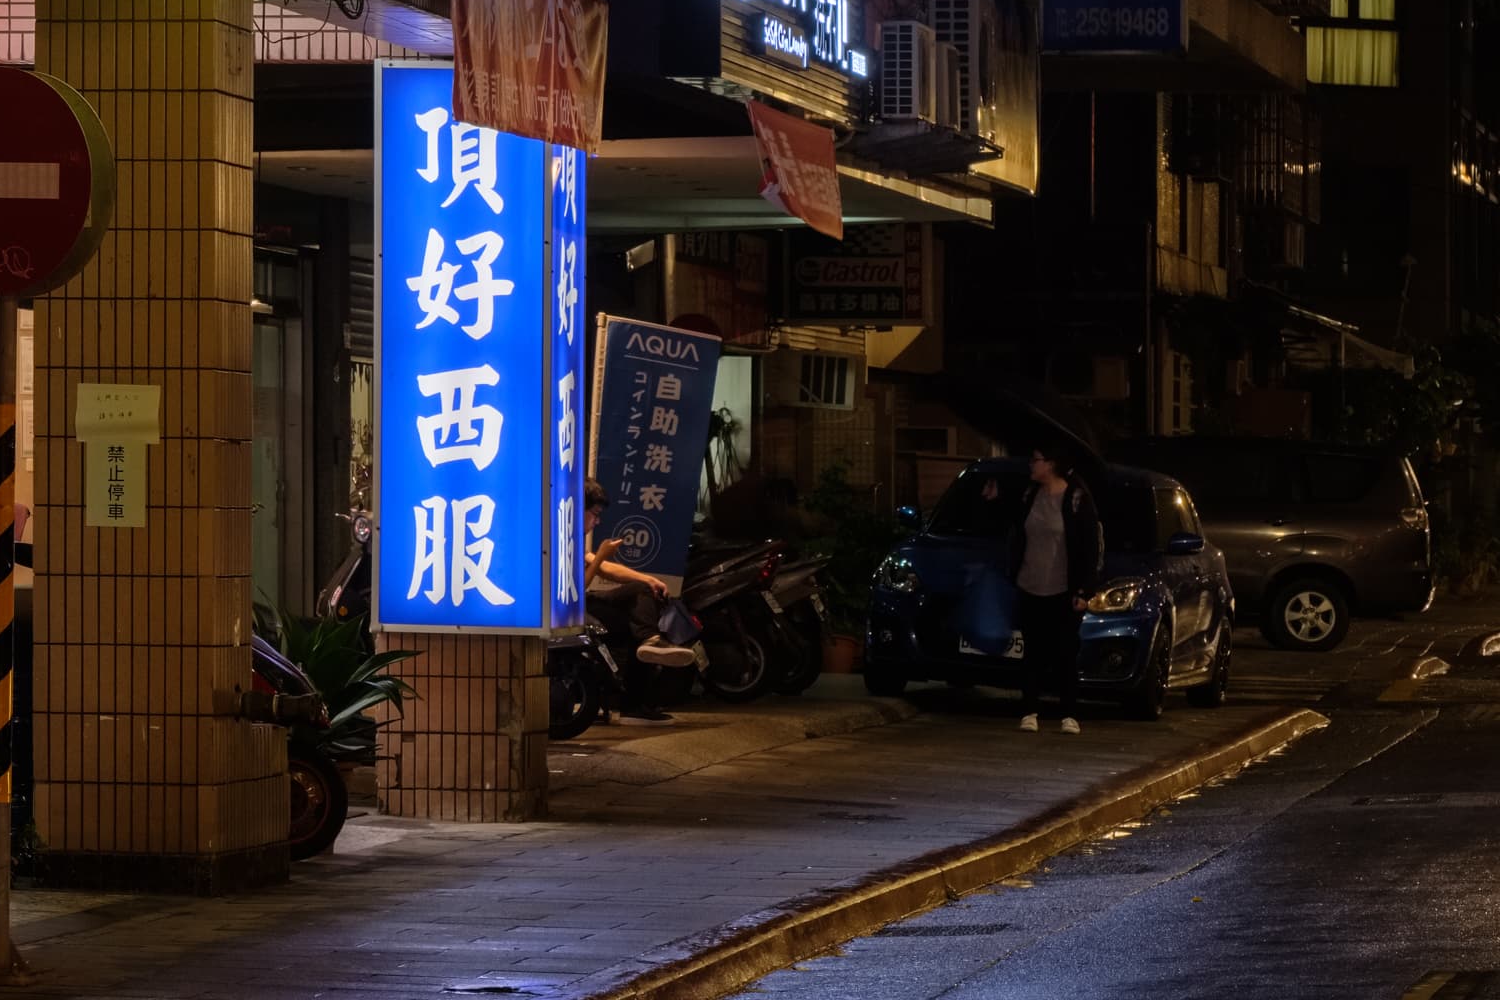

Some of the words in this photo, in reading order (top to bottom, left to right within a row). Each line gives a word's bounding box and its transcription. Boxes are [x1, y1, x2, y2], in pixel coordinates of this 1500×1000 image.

[823, 260, 899, 282] Castrol
[407, 106, 516, 607] 頂好西服
[626, 332, 700, 363] AQUA
[108, 446, 124, 520] 禁止停車
[618, 371, 648, 504] コインランドリー
[639, 373, 682, 512] 自助洗衣
